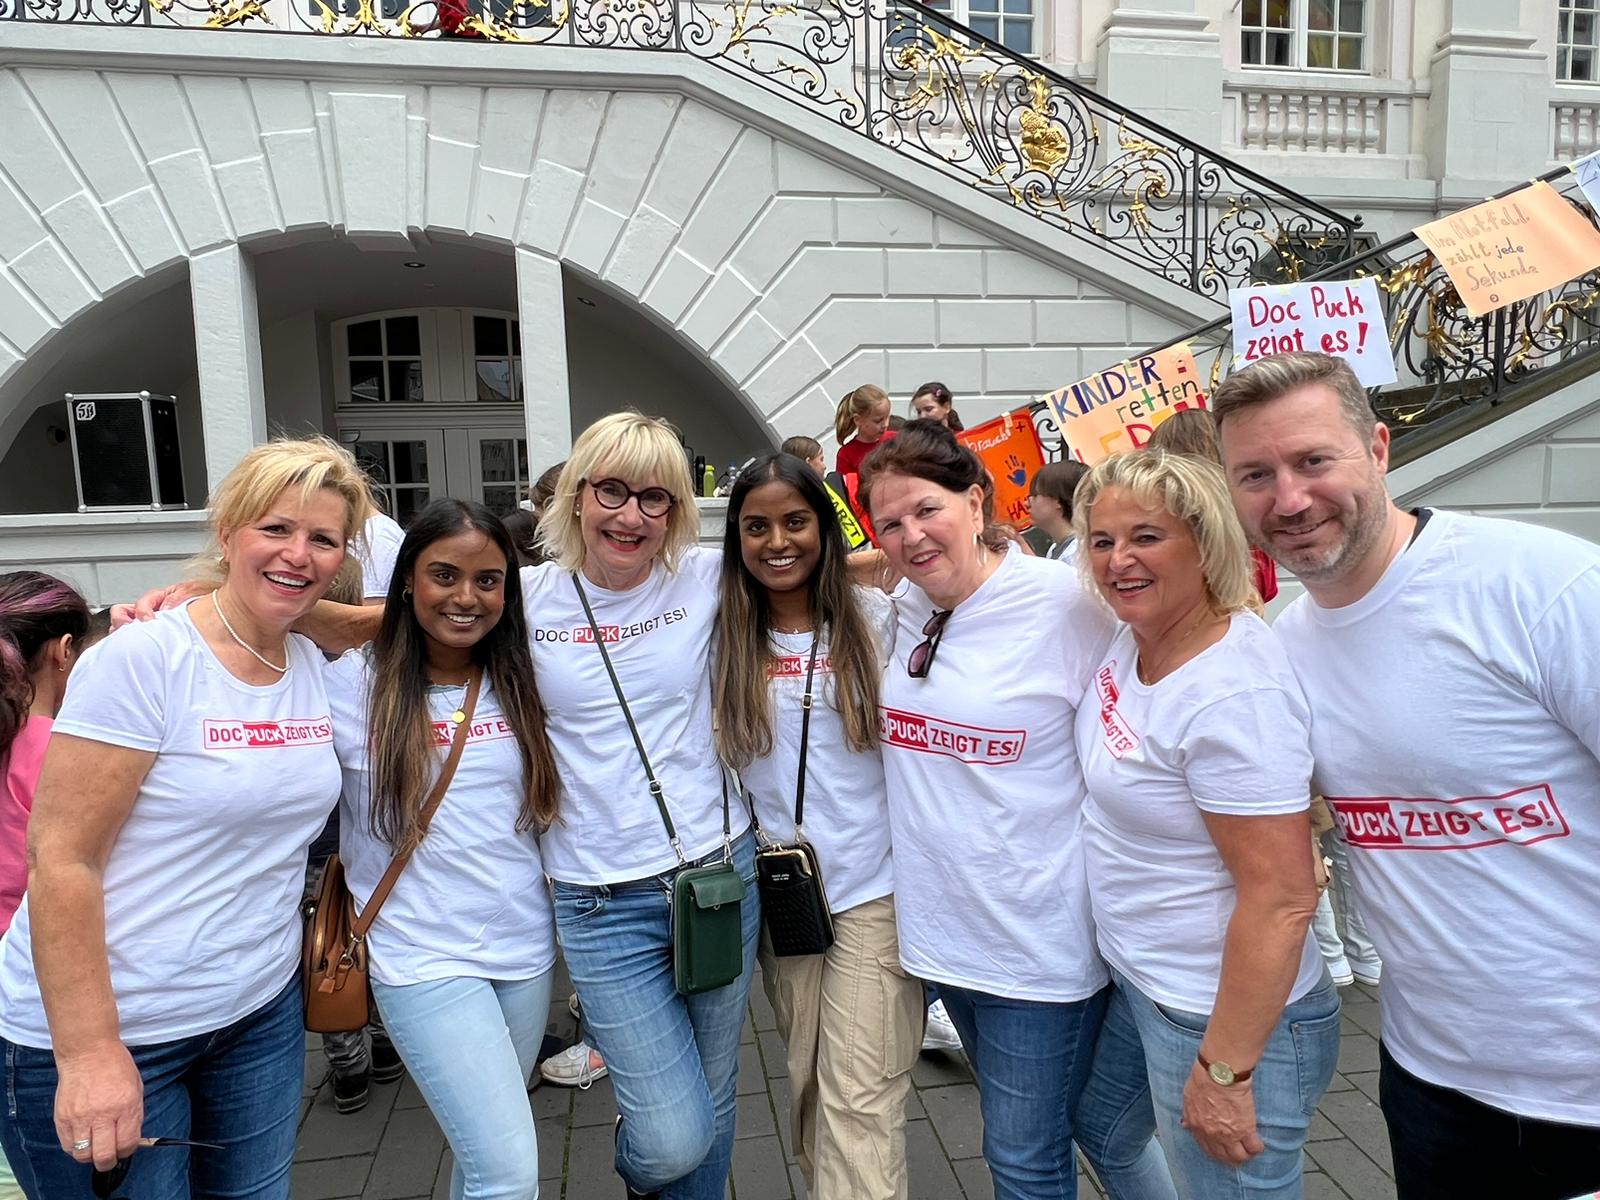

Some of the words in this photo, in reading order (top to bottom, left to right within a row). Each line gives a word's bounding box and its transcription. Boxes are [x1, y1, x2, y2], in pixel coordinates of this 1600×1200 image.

[1446, 241, 1491, 266] zählt
[1495, 236, 1525, 259] jede
[1465, 256, 1539, 292] Sekunde
[1248, 296, 1301, 327] Doc
[1310, 286, 1364, 317] Puck
[1051, 357, 1162, 423] KINDER
[1116, 380, 1199, 423] retten
[534, 629, 569, 642] DOC
[621, 617, 660, 639] ZEIGT
[663, 607, 688, 625] ES!
[209, 727, 242, 742] DOC
[245, 727, 284, 742] PUCK
[284, 726, 313, 740] ZEIGT
[313, 722, 332, 738] ES!
[888, 718, 927, 743] PUCK
[930, 727, 982, 754] ZEIGT
[986, 740, 1019, 756] ES!
[1399, 811, 1489, 837] ZEIGT
[1493, 799, 1555, 834] ES!
